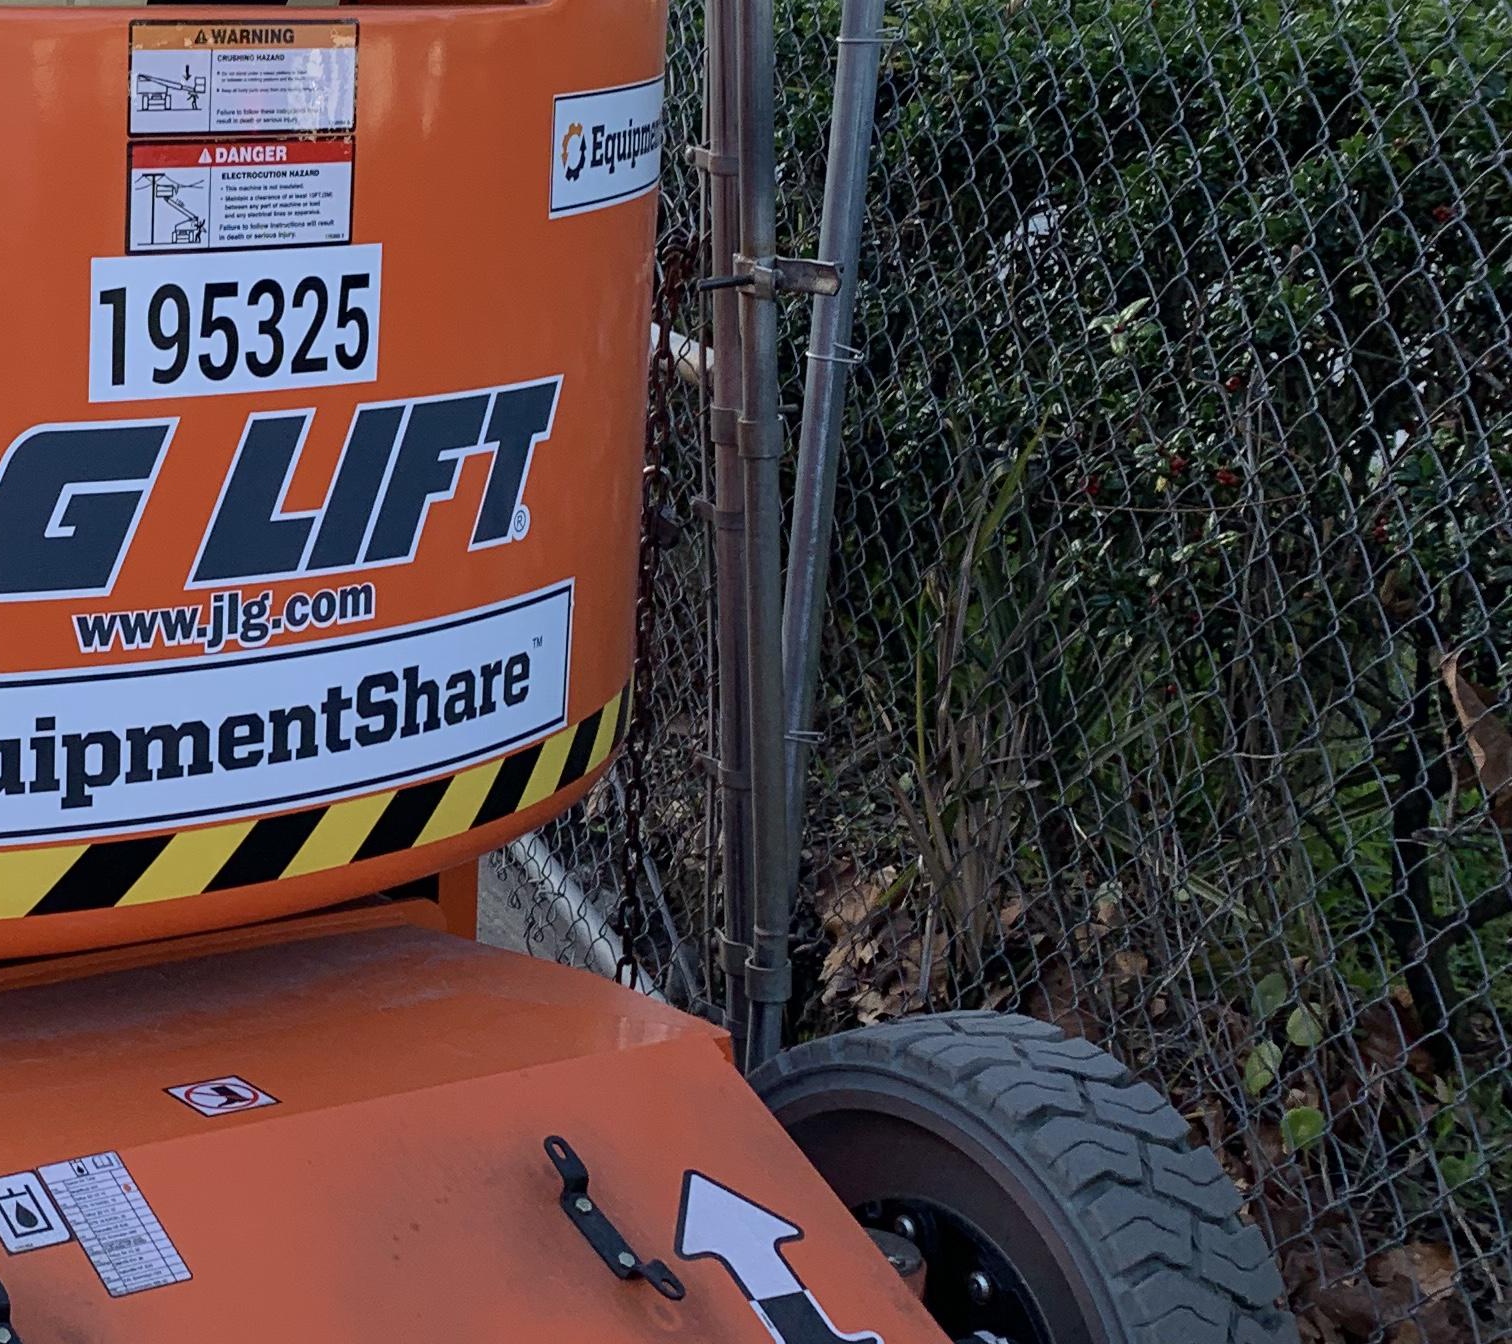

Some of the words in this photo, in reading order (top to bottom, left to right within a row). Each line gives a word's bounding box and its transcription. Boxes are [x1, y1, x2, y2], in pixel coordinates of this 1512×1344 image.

[211, 28, 295, 45] WARNING
[215, 146, 287, 163] DANGER
[221, 171, 286, 179] ELECTROCUTION
[99, 273, 370, 386] 195325
[186, 374, 565, 589] LIFT
[73, 582, 375, 655] www.jlg.com
